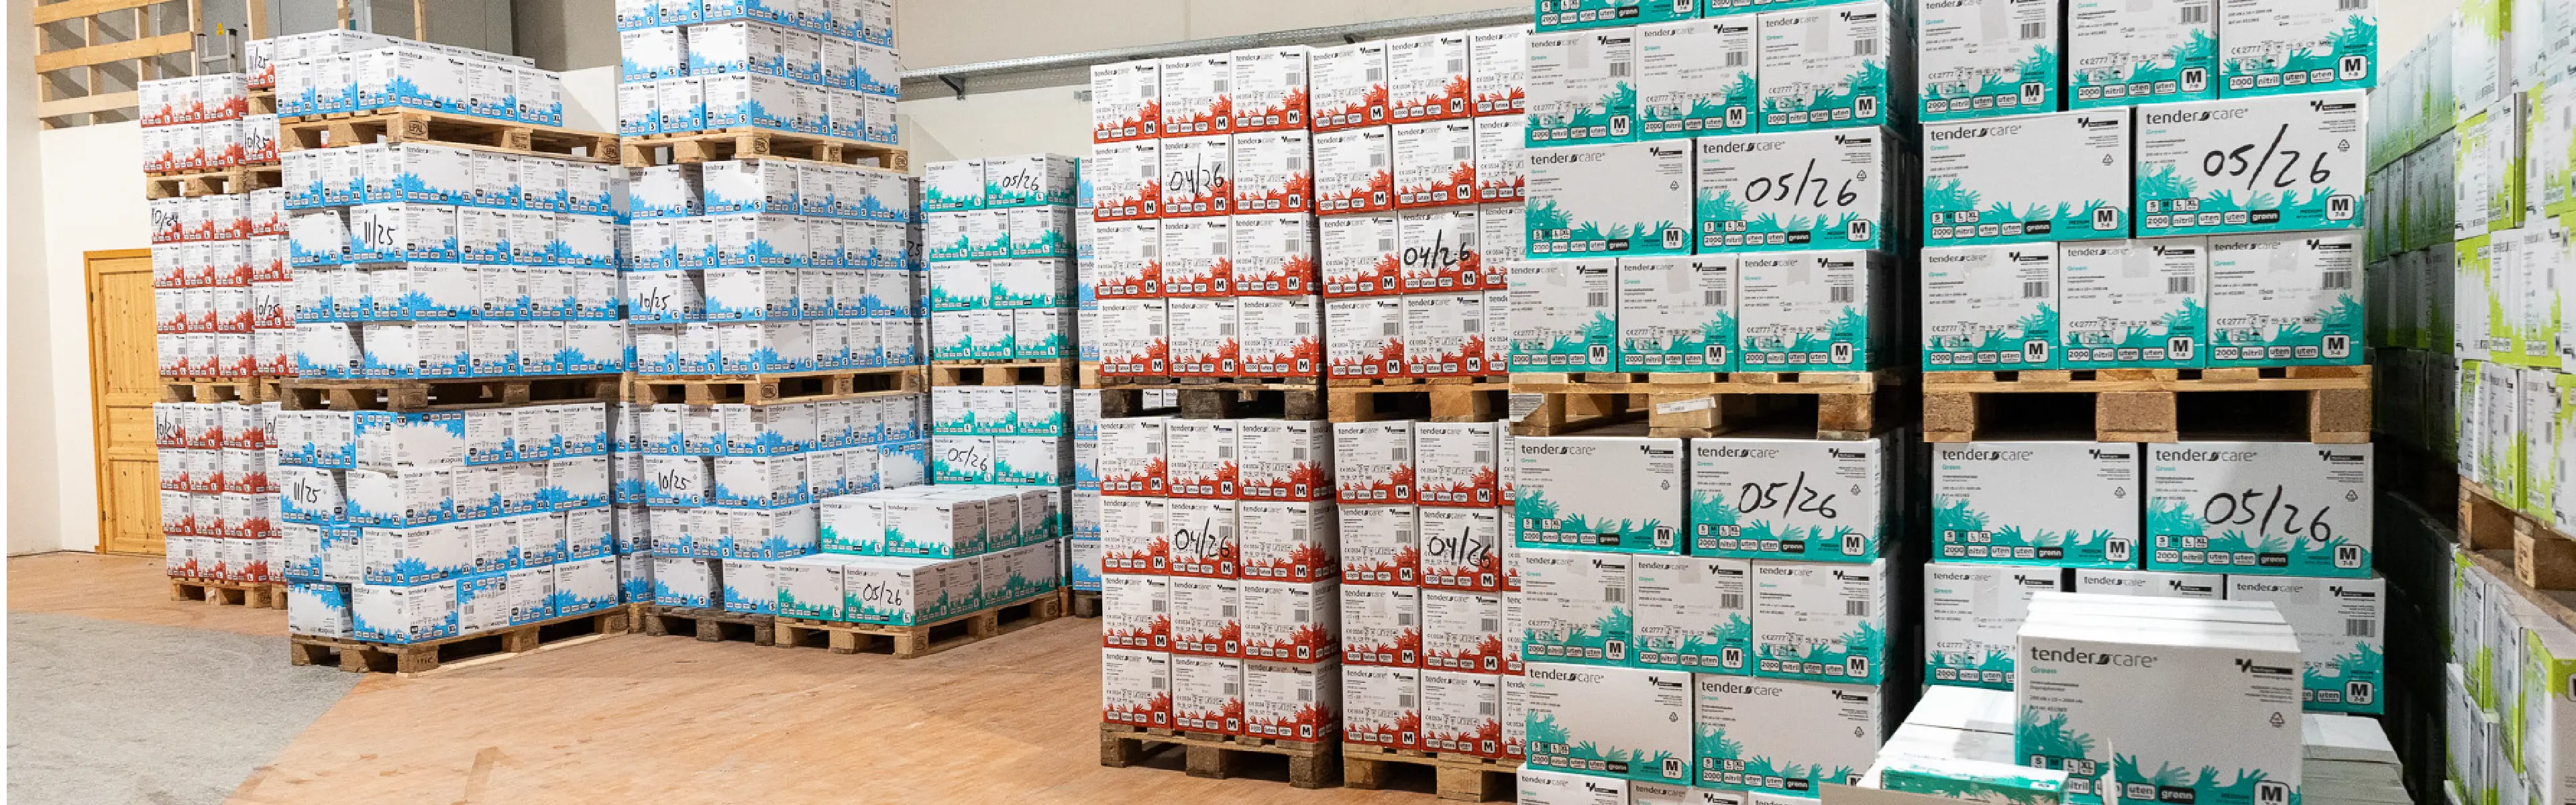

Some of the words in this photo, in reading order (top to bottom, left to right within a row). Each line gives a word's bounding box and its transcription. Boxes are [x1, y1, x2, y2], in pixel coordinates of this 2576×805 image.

[2345, 59, 2360, 72] M
[2187, 70, 2201, 83] M
[2025, 85, 2039, 97] M
[1453, 101, 1460, 109] M
[1860, 99, 1872, 111] M
[2147, 111, 2198, 124] tender
[1931, 127, 1976, 141] tender
[1704, 142, 1747, 153] tender
[1531, 153, 1568, 164] tender
[2204, 124, 2330, 190] 05/26
[1003, 168, 1039, 191] 05/26
[1169, 153, 1223, 197] 04/26
[1746, 158, 1856, 207] 05/26
[2096, 208, 2112, 222] M
[364, 214, 396, 250] 11/25
[1854, 222, 1865, 233] M
[1666, 231, 1678, 241] M
[1403, 229, 1469, 269] 04/26
[640, 287, 669, 313] 10/25
[2029, 343, 2043, 354] M
[2328, 337, 2344, 349] M
[1593, 347, 1604, 358] M
[1709, 347, 1721, 358] M
[1836, 345, 1847, 355] M
[1522, 444, 1558, 454] tender
[1698, 447, 1739, 457] tender
[1943, 449, 1989, 460] tender
[2156, 449, 2209, 461] tender
[947, 447, 987, 472] 05/26
[659, 470, 689, 490] 10/25
[295, 479, 321, 503] 11/25
[1739, 472, 1836, 519] 05/26
[2202, 486, 2330, 543] 05/26
[1174, 517, 1230, 559] 04/26
[1658, 529, 1669, 541] M
[1429, 527, 1491, 568] 04/26
[1847, 537, 1860, 549] M
[2110, 542, 2125, 553] M
[1222, 563, 1232, 572] M
[1402, 570, 1411, 578] M
[863, 581, 901, 605] 05/26
[1727, 651, 1738, 663] M
[2031, 647, 2094, 663] tender
[1851, 659, 1864, 672] M
[1529, 669, 1568, 680] tender
[1702, 682, 1743, 693] tender
[2351, 684, 2367, 696] M
[1155, 714, 1163, 723] M
[2066, 780, 2089, 790] itril
[2129, 786, 2152, 794] uten
[2262, 786, 2282, 802] M
[2262, 786, 2282, 802] M
